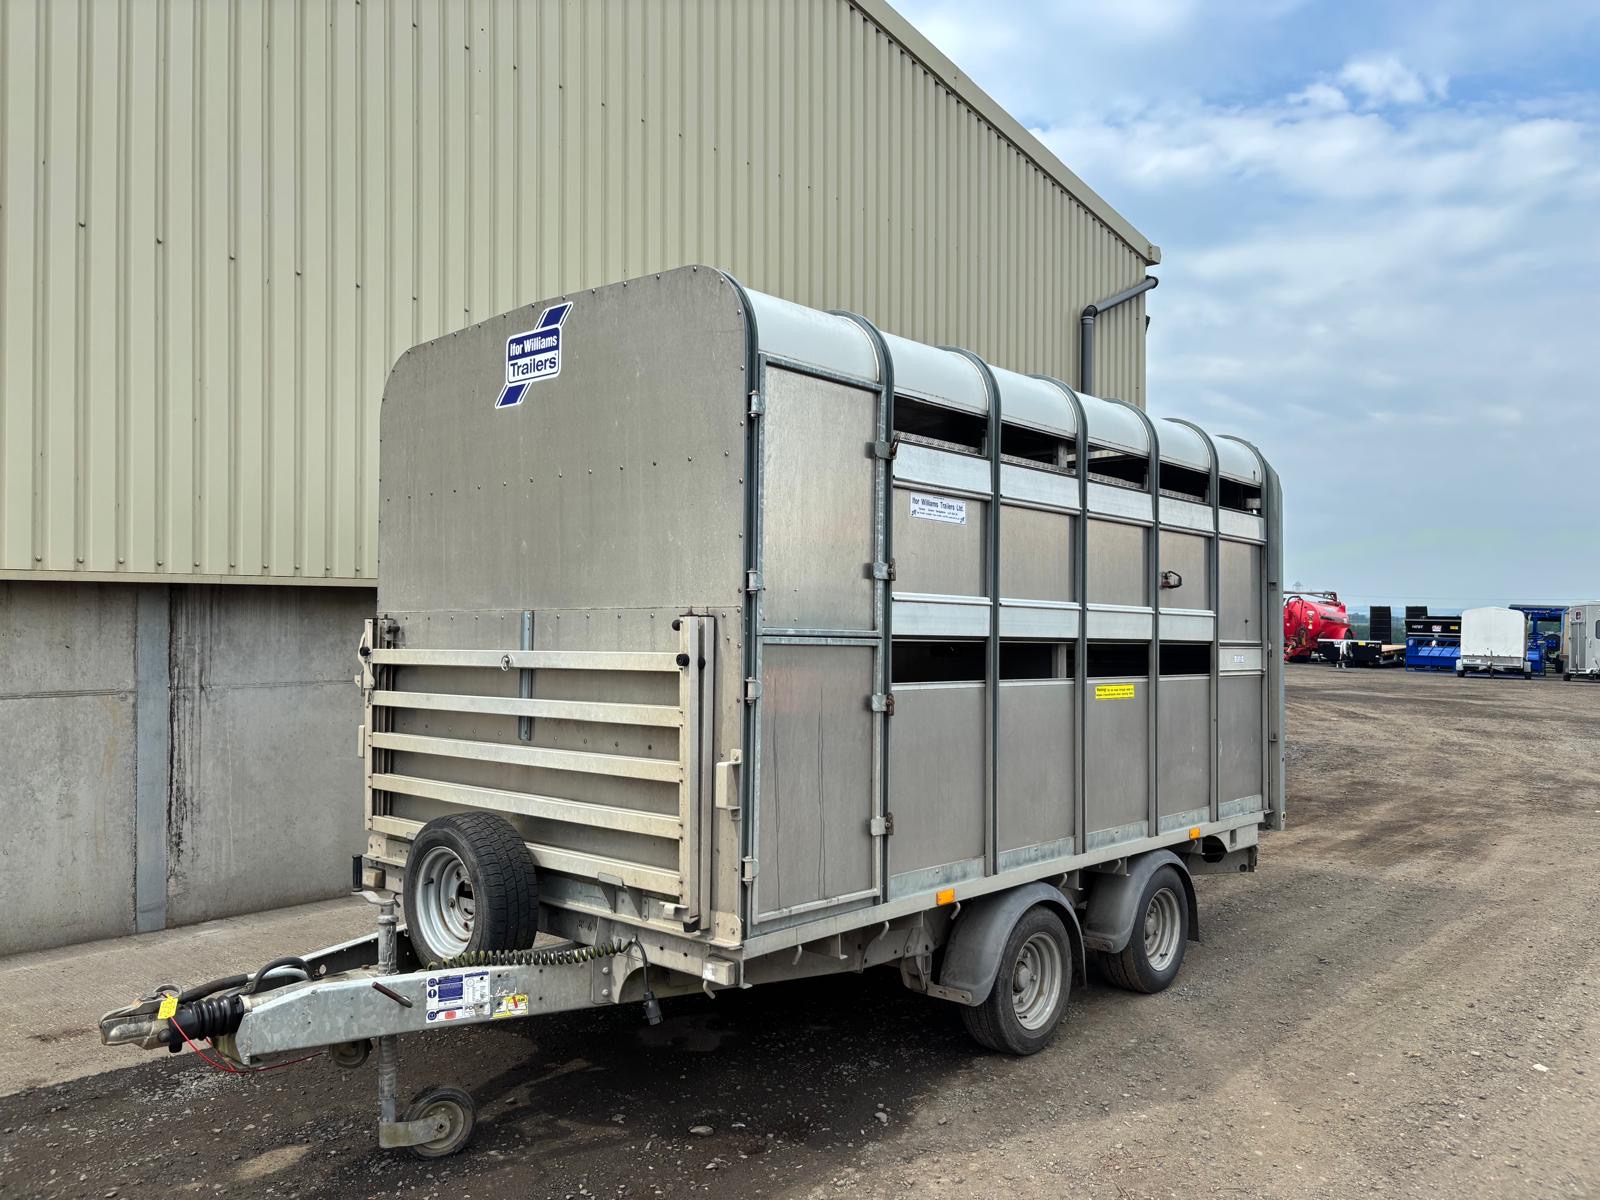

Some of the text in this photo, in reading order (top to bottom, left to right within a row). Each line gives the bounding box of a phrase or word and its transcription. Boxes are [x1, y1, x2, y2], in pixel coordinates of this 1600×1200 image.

[510, 336, 558, 356] Ifor Williams
[510, 357, 557, 377] Trailers
[921, 498, 939, 508] Williams
[940, 502, 955, 511] Trailers
